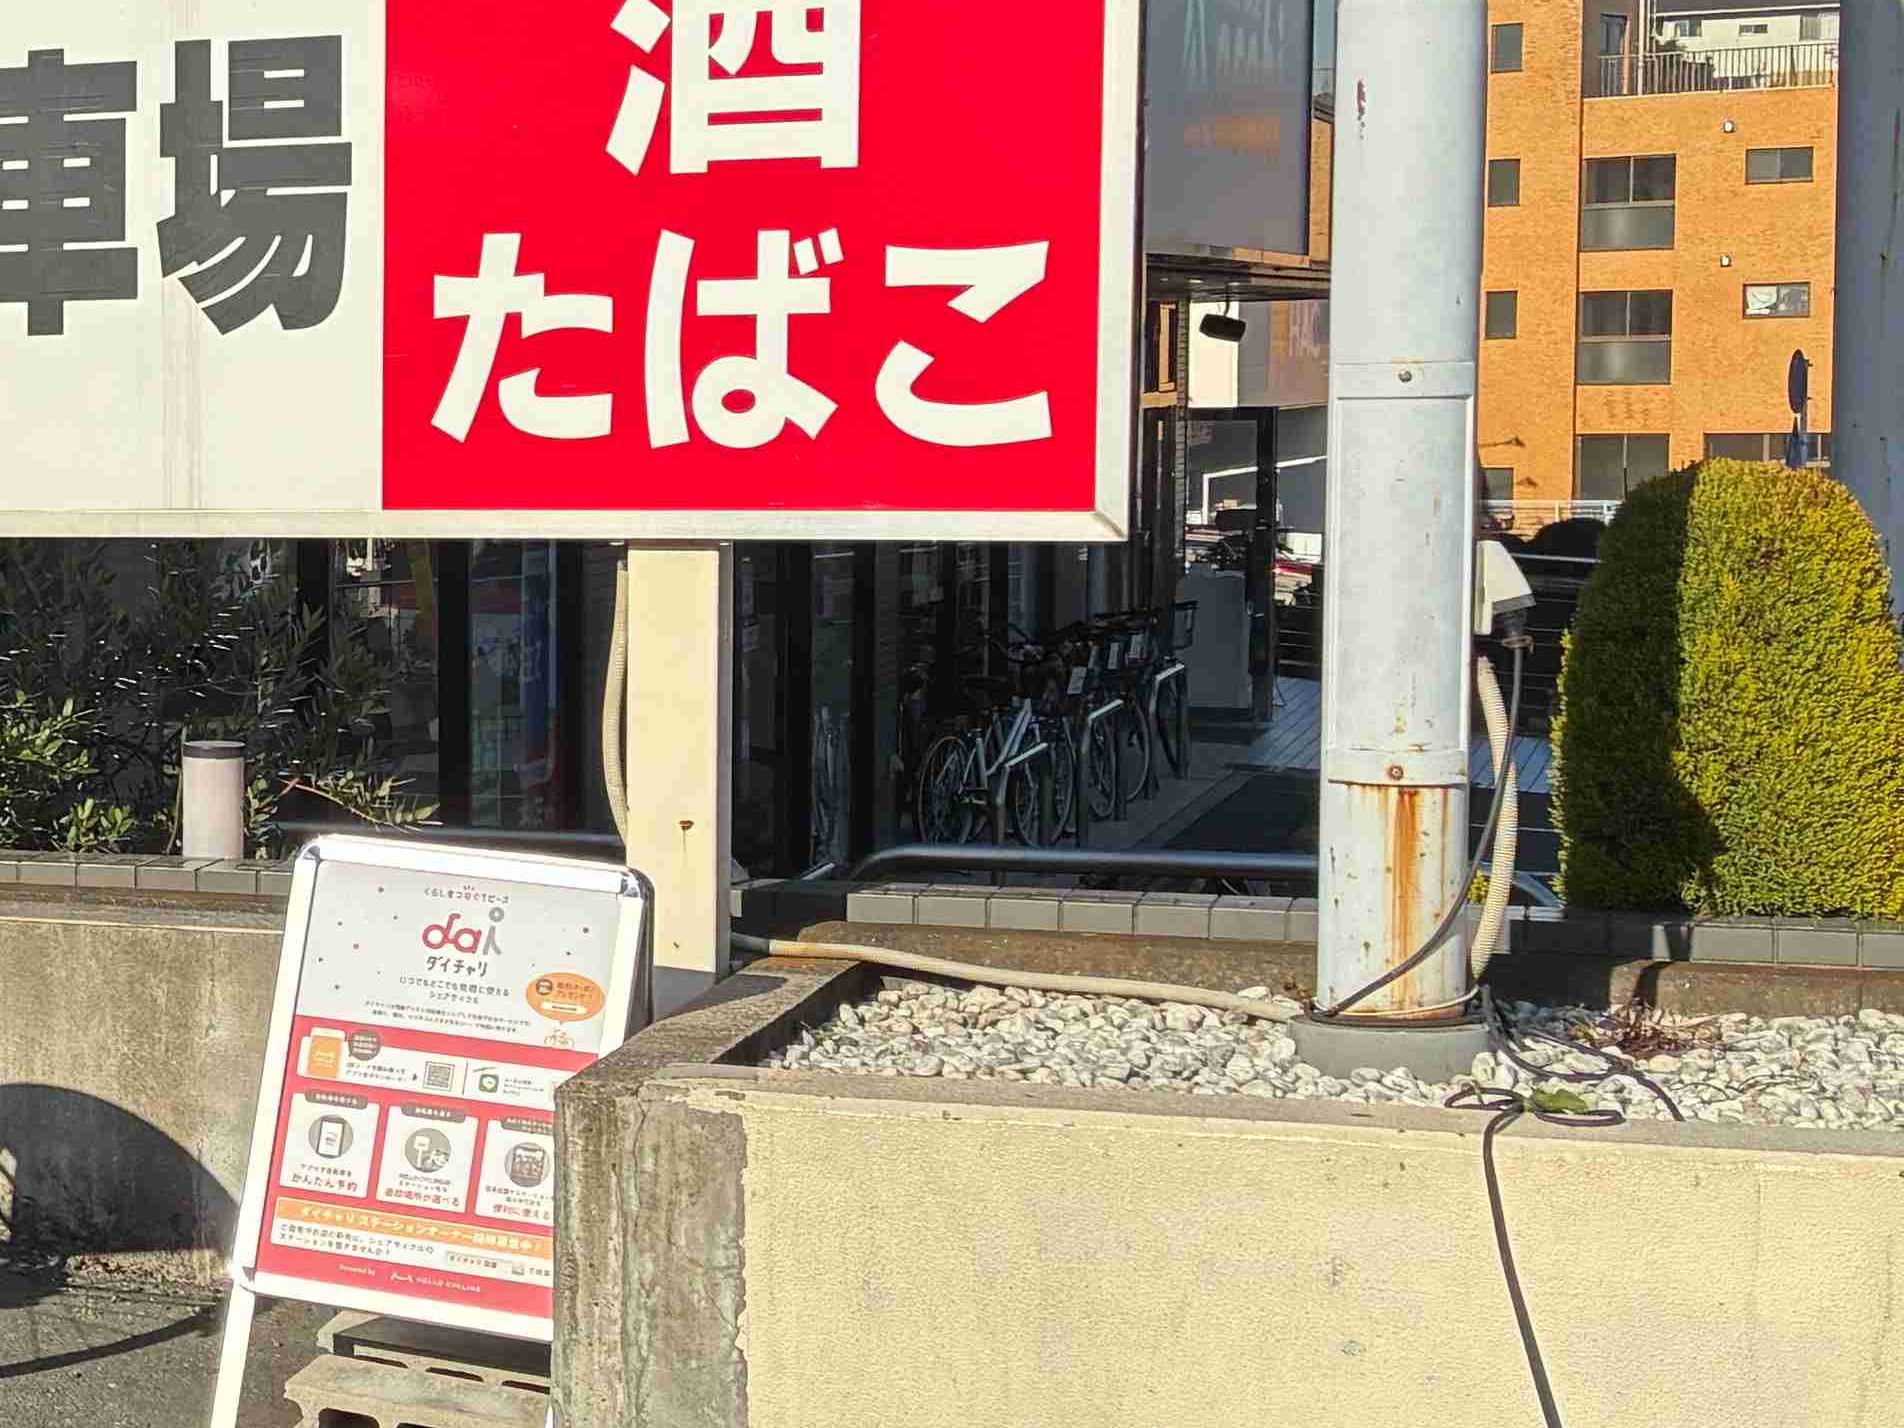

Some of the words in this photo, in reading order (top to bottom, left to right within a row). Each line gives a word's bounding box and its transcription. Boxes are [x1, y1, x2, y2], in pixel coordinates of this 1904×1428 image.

[430, 229, 1052, 448] たばこ
[422, 906, 504, 956] dai
[426, 955, 488, 977] ダイチャリ
